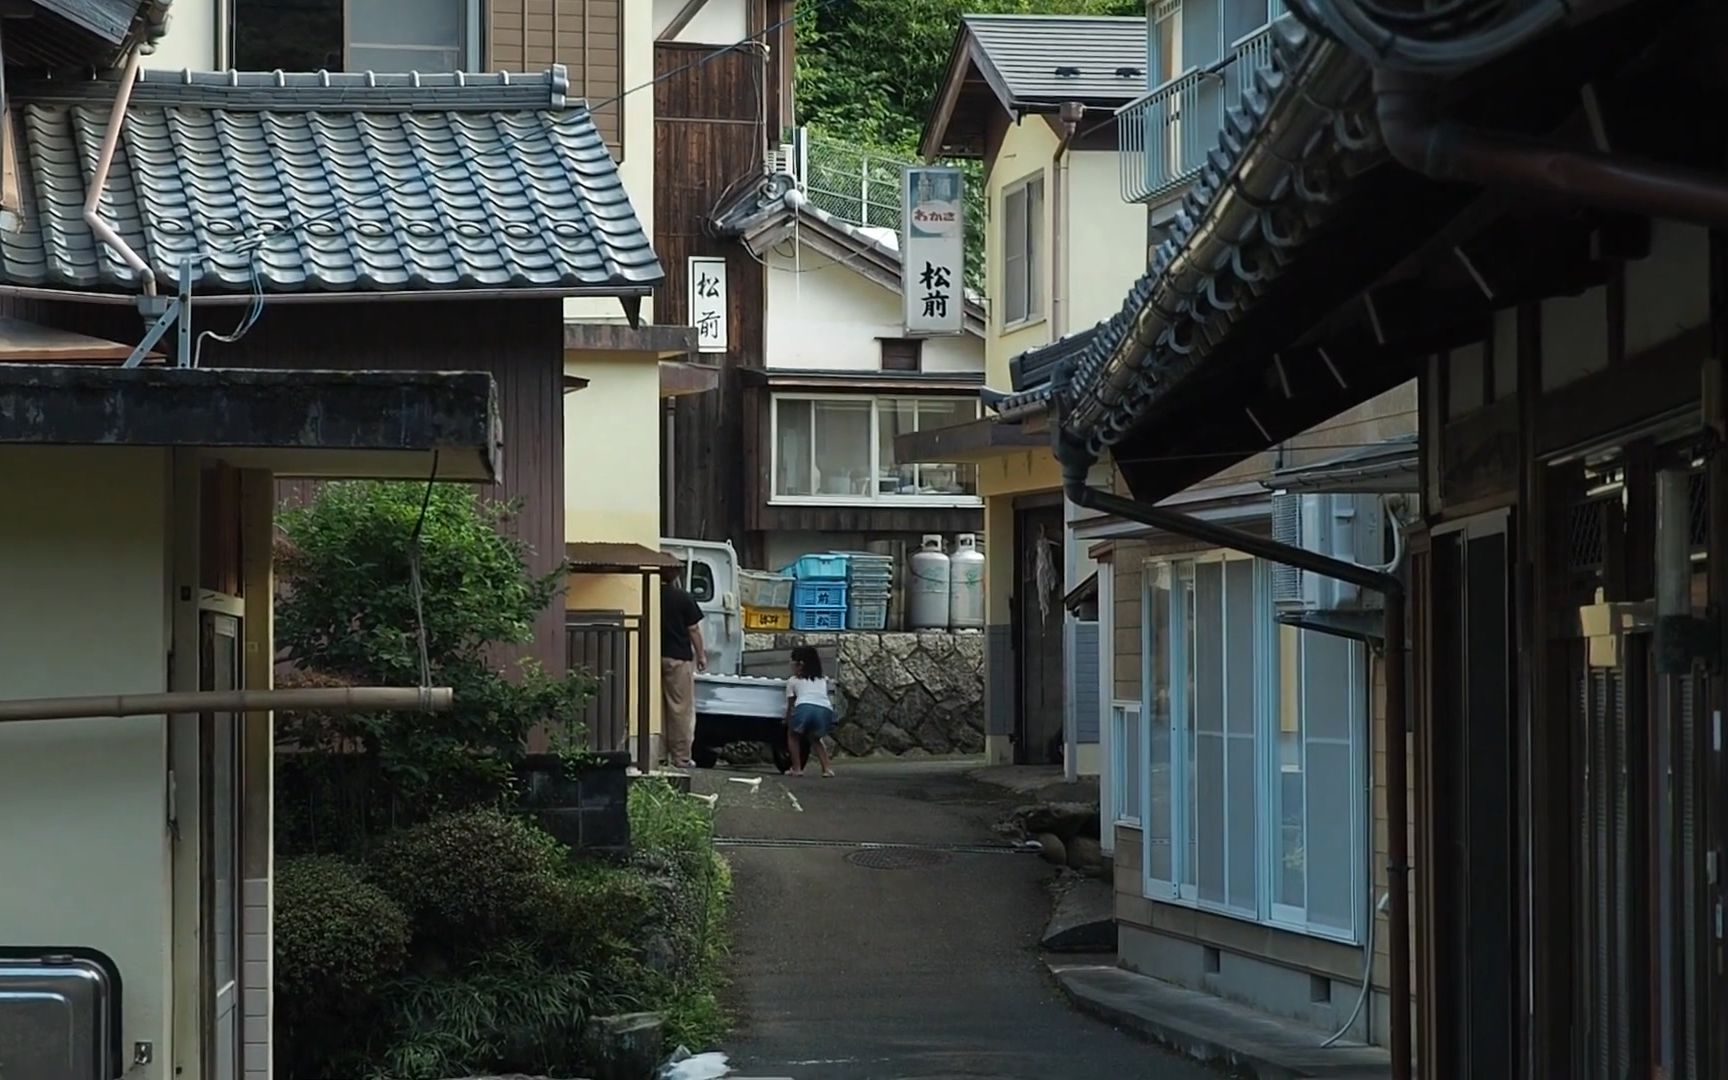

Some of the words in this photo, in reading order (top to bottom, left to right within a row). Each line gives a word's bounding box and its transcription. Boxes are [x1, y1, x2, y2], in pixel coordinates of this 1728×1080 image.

[914, 208, 955, 222] わかさ
[696, 271, 721, 339] 松前
[919, 260, 952, 318] 松前
